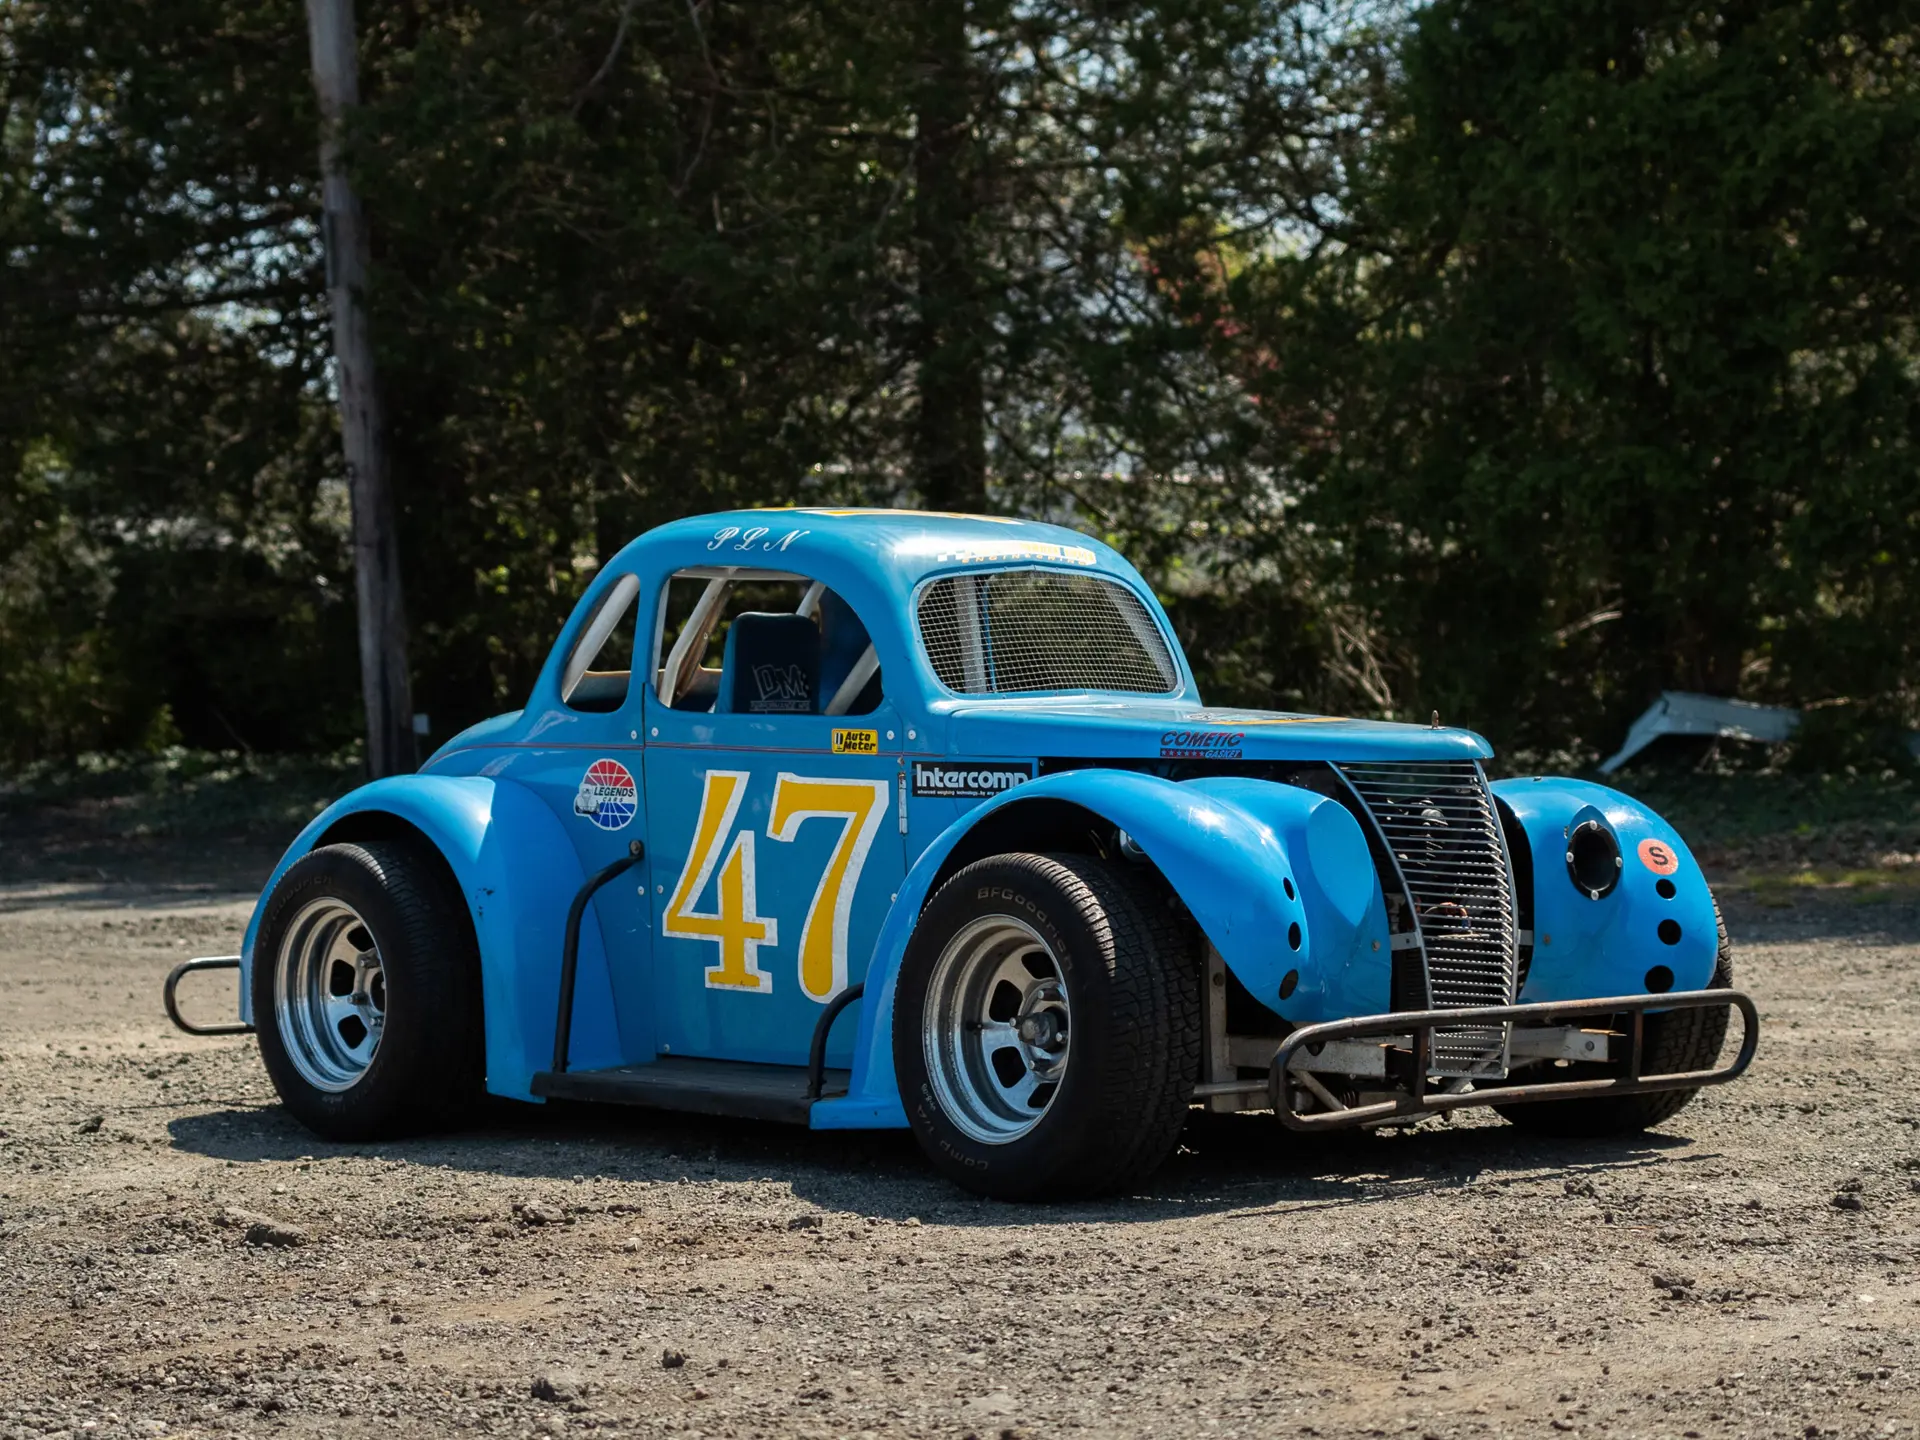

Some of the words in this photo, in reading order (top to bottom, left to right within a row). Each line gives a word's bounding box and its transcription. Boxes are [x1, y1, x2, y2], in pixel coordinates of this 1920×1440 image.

[845, 731, 872, 742] Auto
[1160, 731, 1245, 747] COMETIC
[843, 741, 876, 752] Meter
[1205, 750, 1241, 758] GASKET
[594, 787, 634, 797] LEGENDS
[1648, 846, 1669, 866] S
[663, 769, 889, 1004] 47
